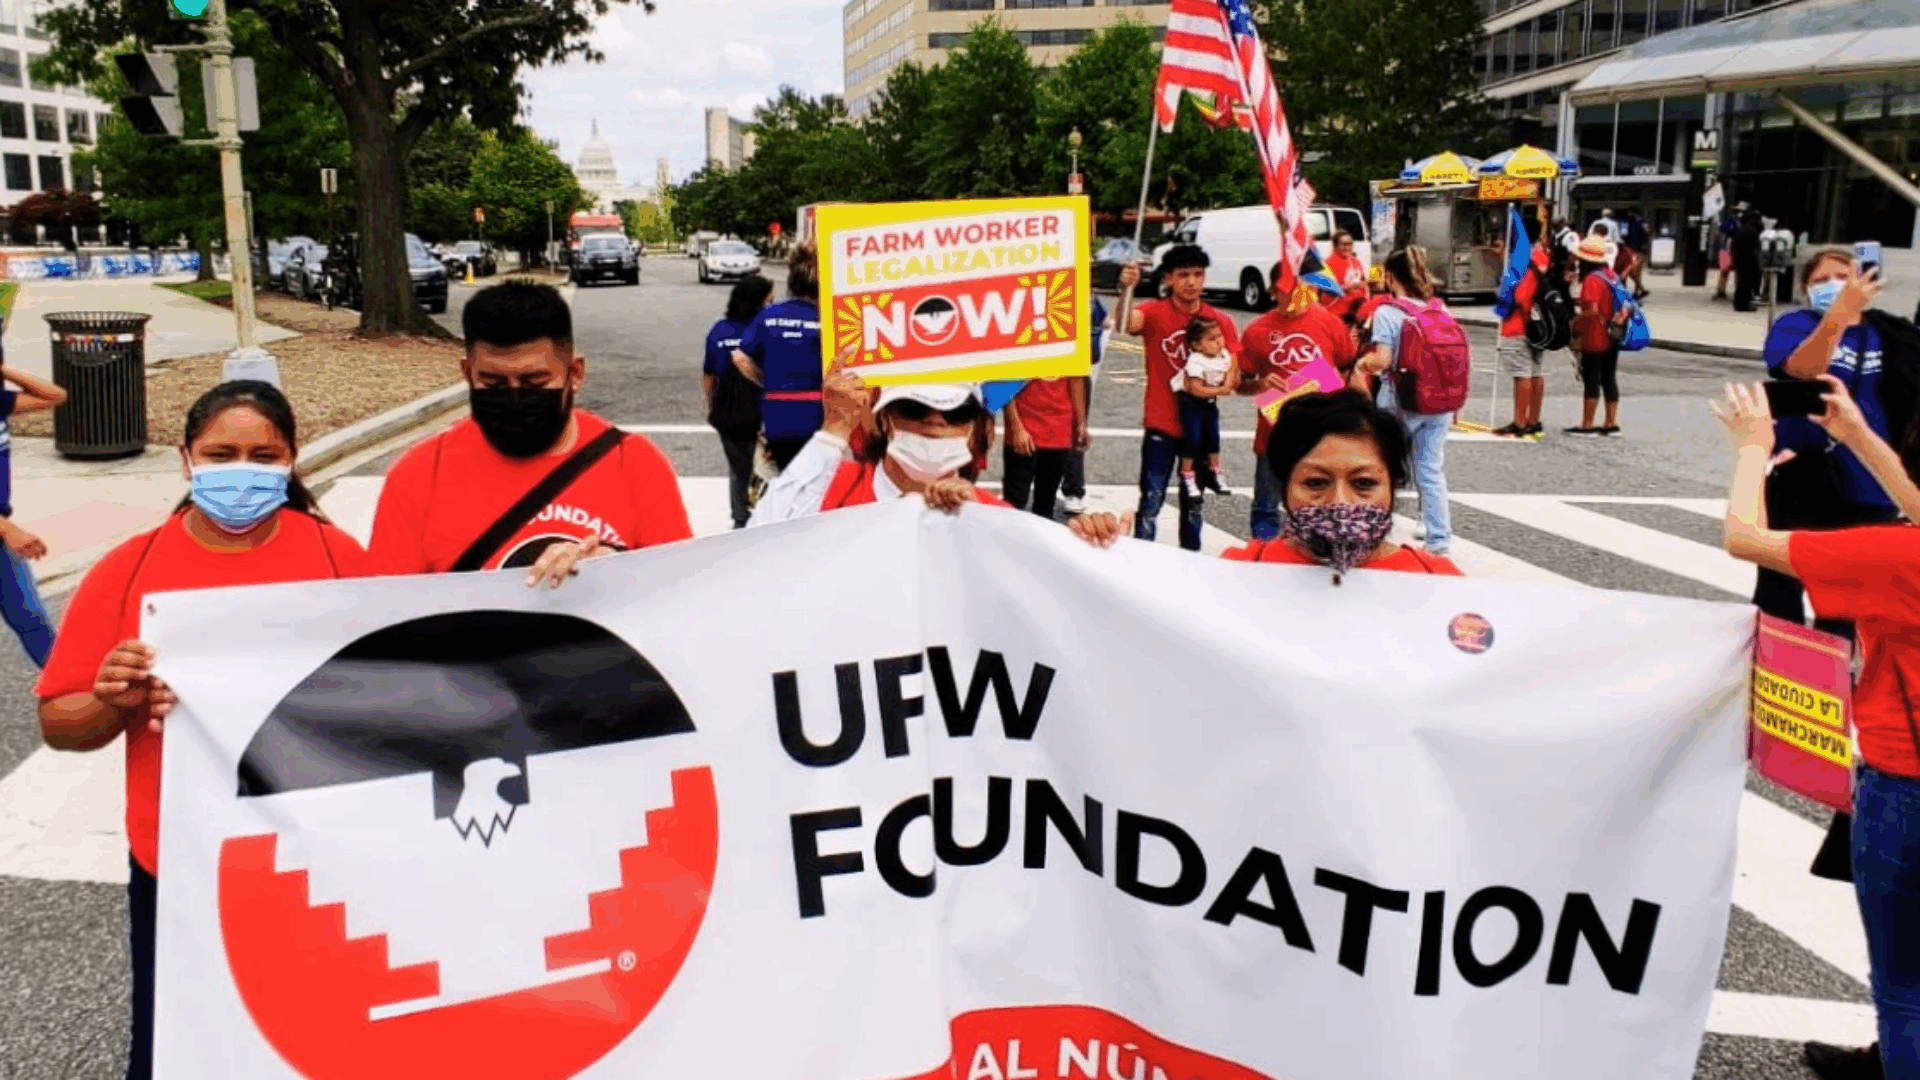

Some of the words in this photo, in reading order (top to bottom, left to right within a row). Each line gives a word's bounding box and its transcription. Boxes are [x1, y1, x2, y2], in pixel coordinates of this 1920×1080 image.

[1695, 131, 1717, 149] M
[846, 230, 924, 257] FARM
[934, 215, 1059, 248] WORKER
[847, 240, 1060, 285] LEGALIZATION
[1269, 344, 1323, 367] CASA
[773, 647, 1055, 767] UFW
[1819, 697, 1840, 720] LA
[791, 777, 1660, 995] FOUNDATION
[967, 1039, 1038, 1080] AL
